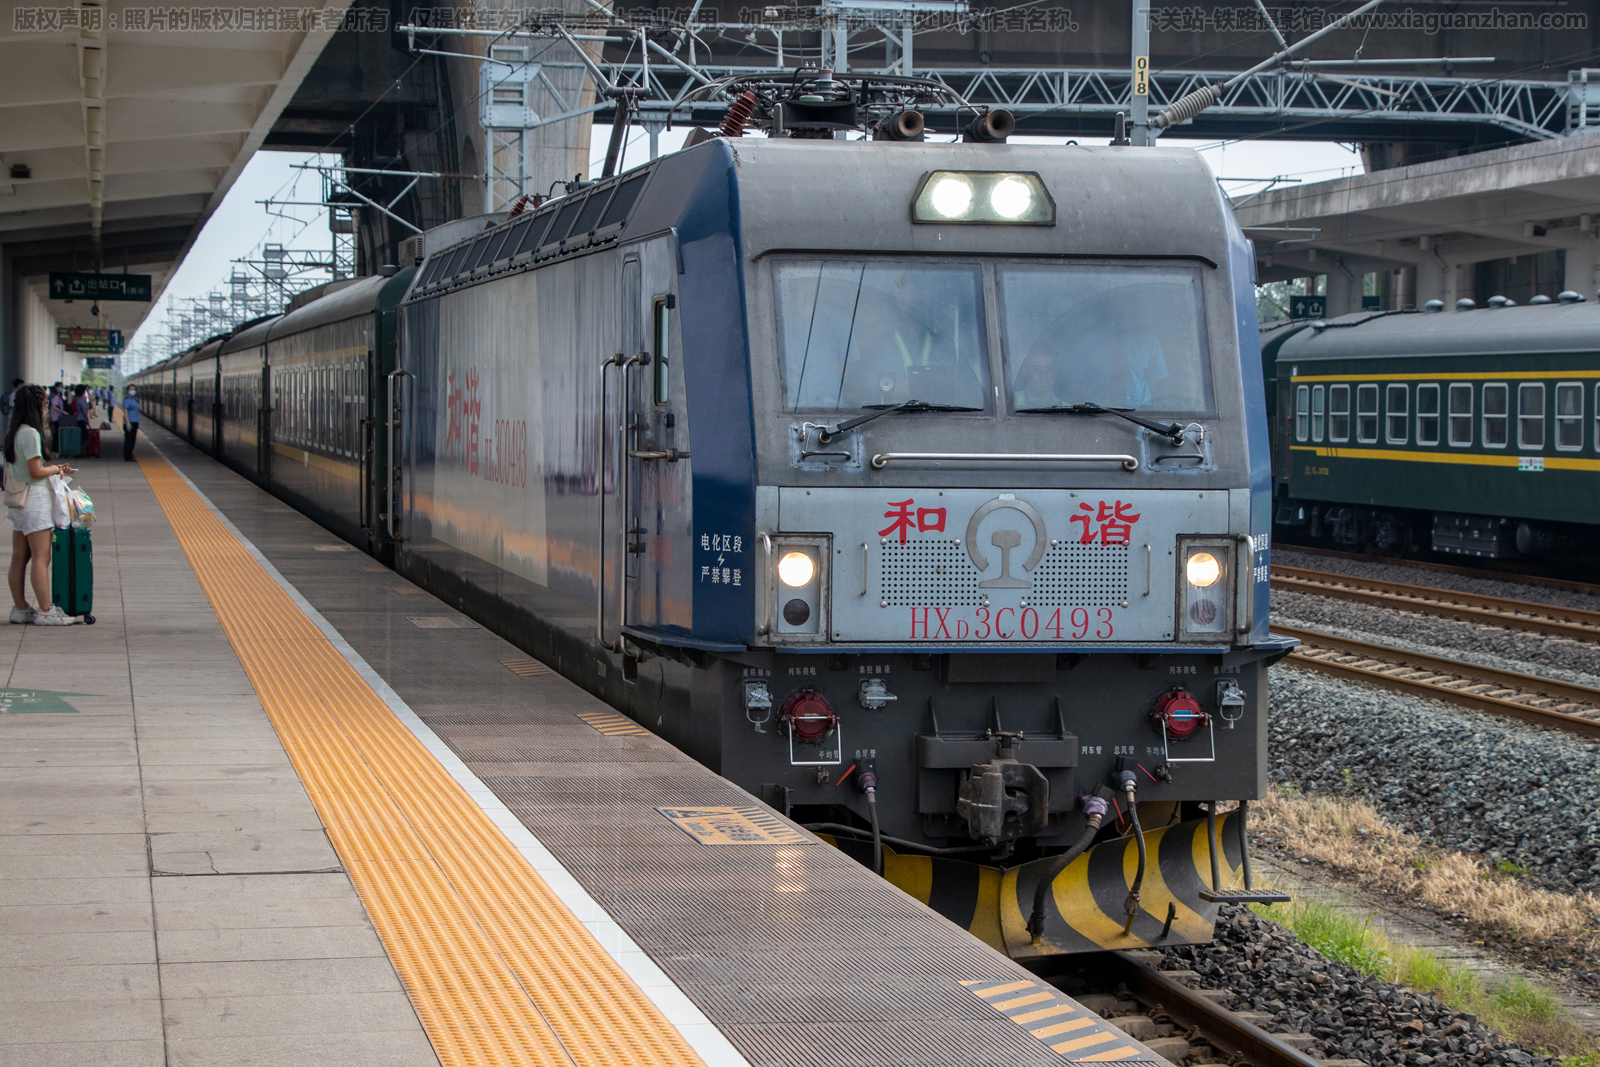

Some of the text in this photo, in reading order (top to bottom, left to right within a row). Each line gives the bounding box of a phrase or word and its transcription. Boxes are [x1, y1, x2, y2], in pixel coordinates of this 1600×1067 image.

[1137, 57, 1147, 94] 018
[878, 498, 947, 546] 和
[1070, 500, 1141, 547] 谐
[701, 532, 743, 553] 电化区段
[700, 565, 742, 586] 严禁攀登
[909, 606, 1114, 640] HXD3C0493
[788, 667, 817, 676] 列车供电
[1169, 666, 1197, 675] 列车供电
[1081, 745, 1103, 755] 列车管
[1113, 745, 1135, 755] 总风管
